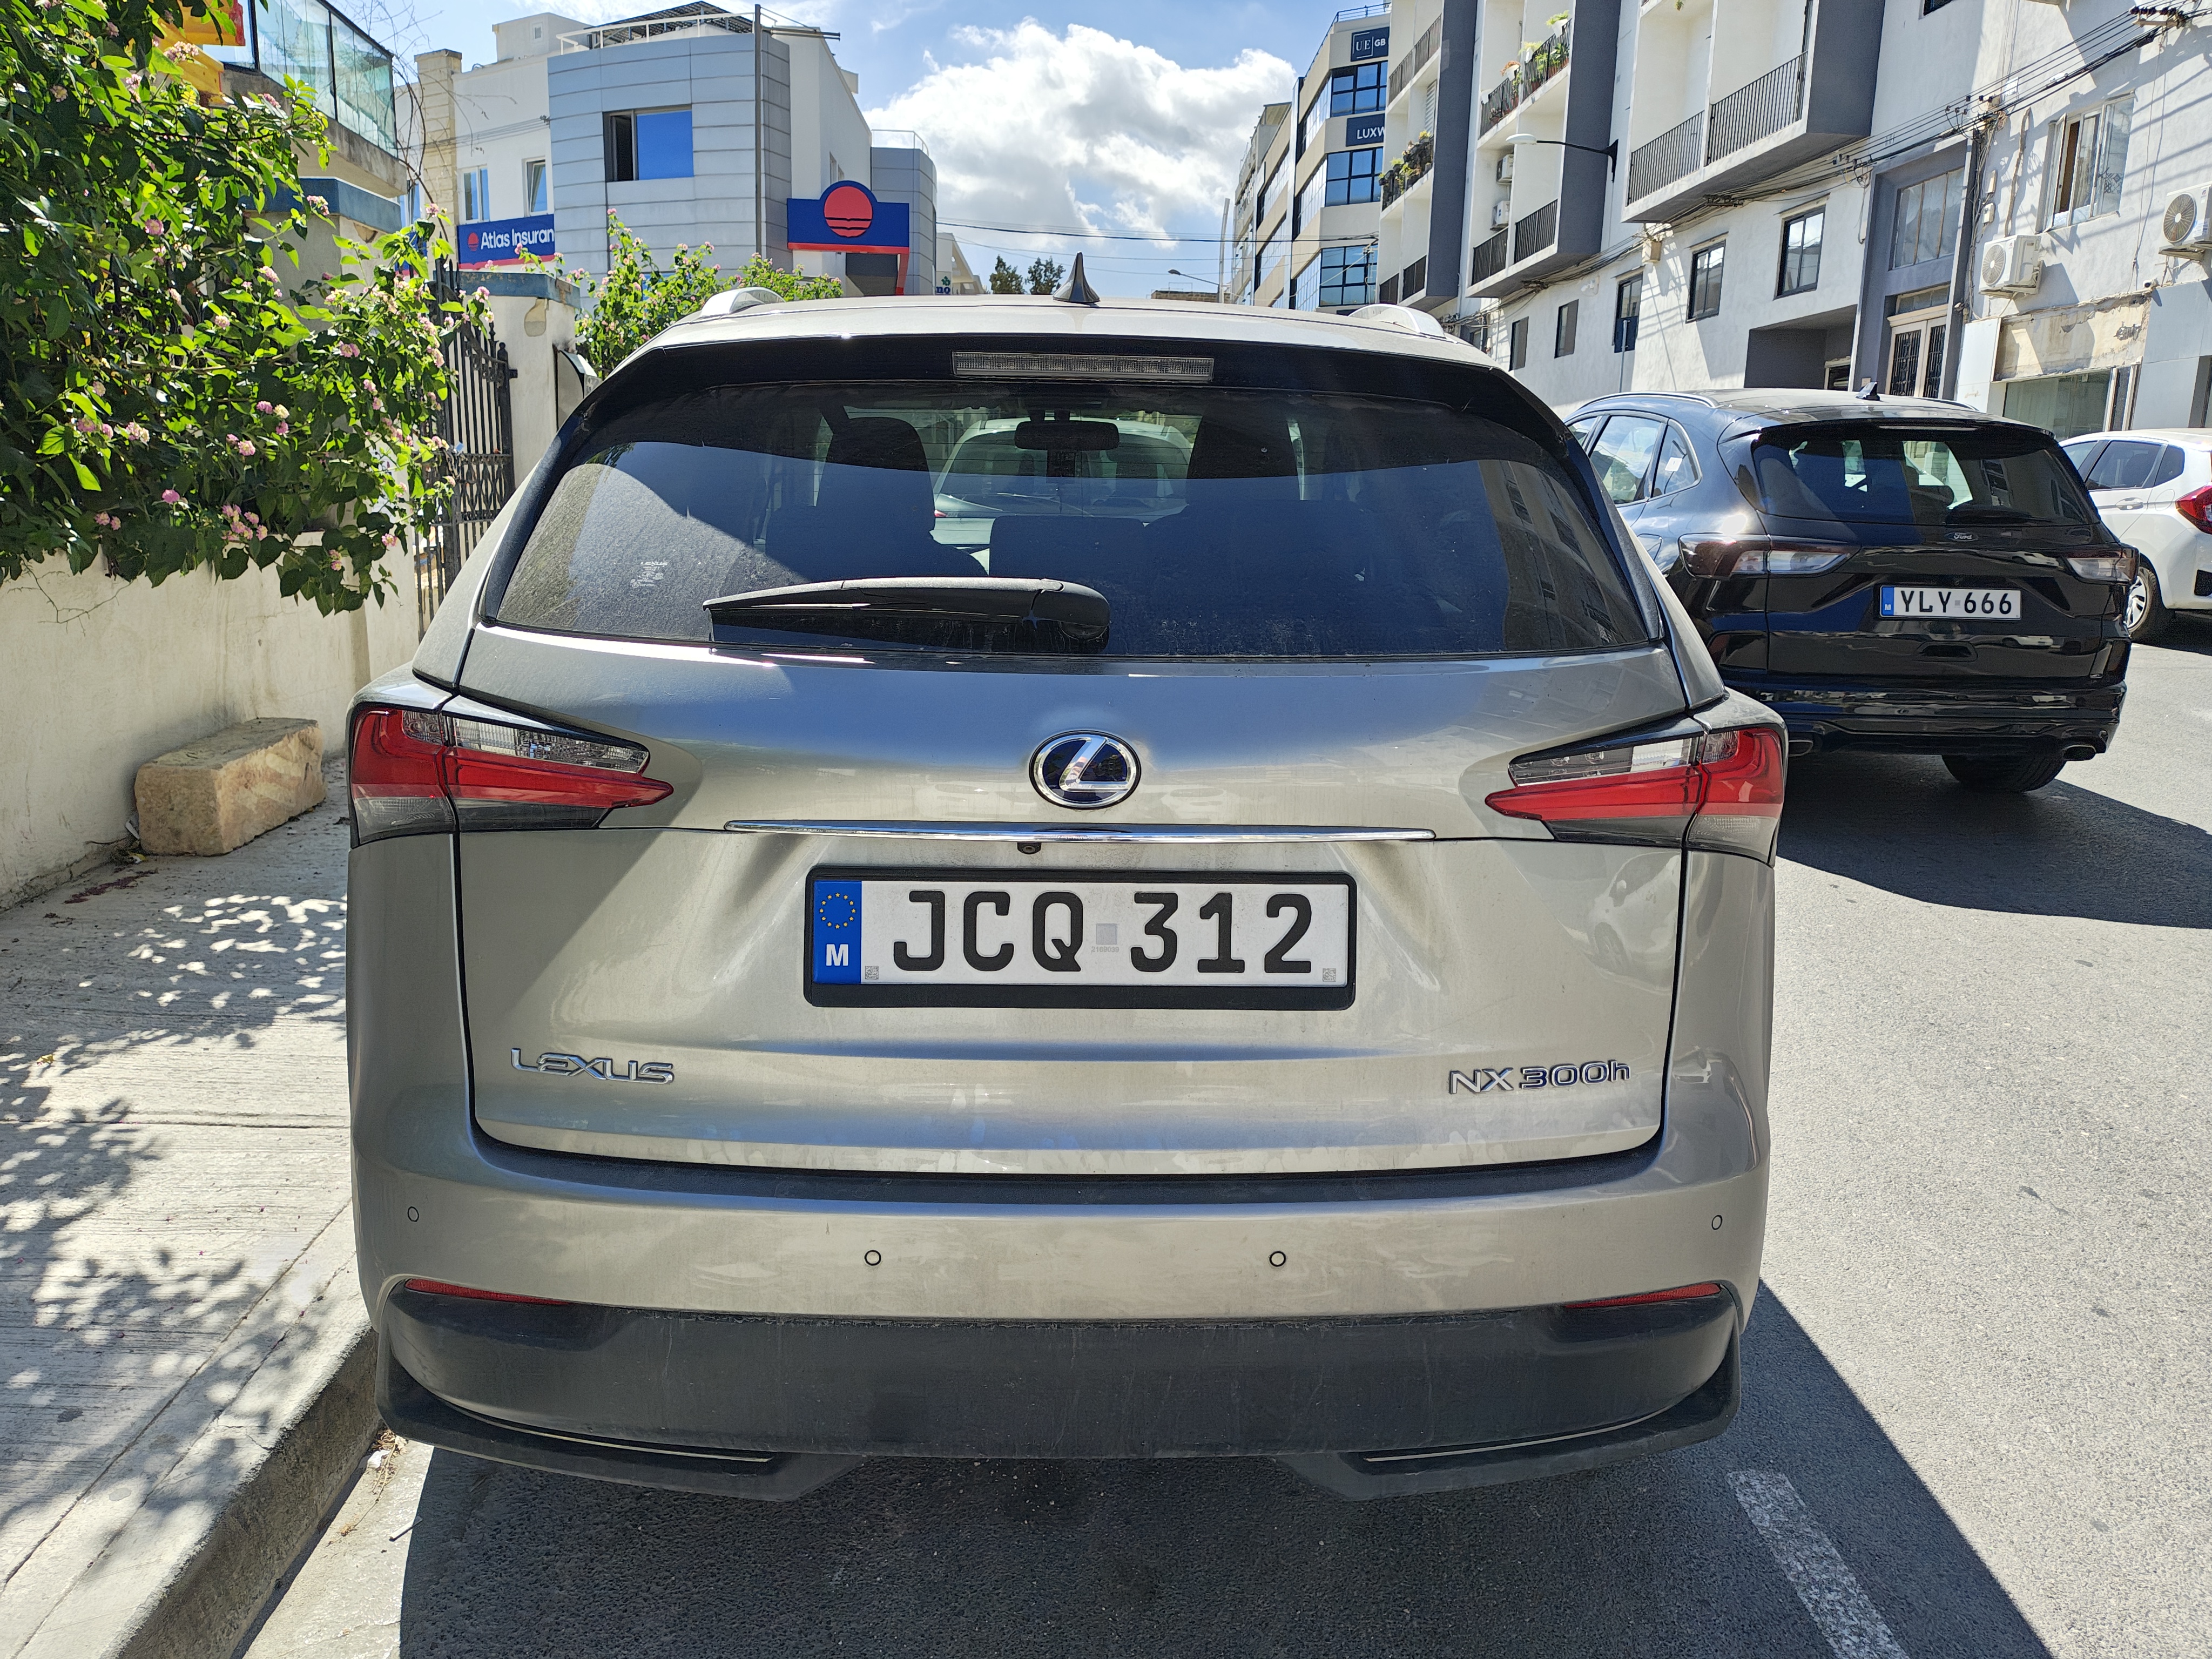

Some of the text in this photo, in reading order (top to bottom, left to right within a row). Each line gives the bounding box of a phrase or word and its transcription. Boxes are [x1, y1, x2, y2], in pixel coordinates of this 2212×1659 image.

[1374, 38, 1386, 47] GB
[481, 227, 554, 249] Atlas Insuran
[1900, 590, 1952, 613] YLY
[1964, 592, 2012, 615] 666
[826, 890, 1312, 974] M JCQ 312
[510, 1047, 675, 1084] LEXUS
